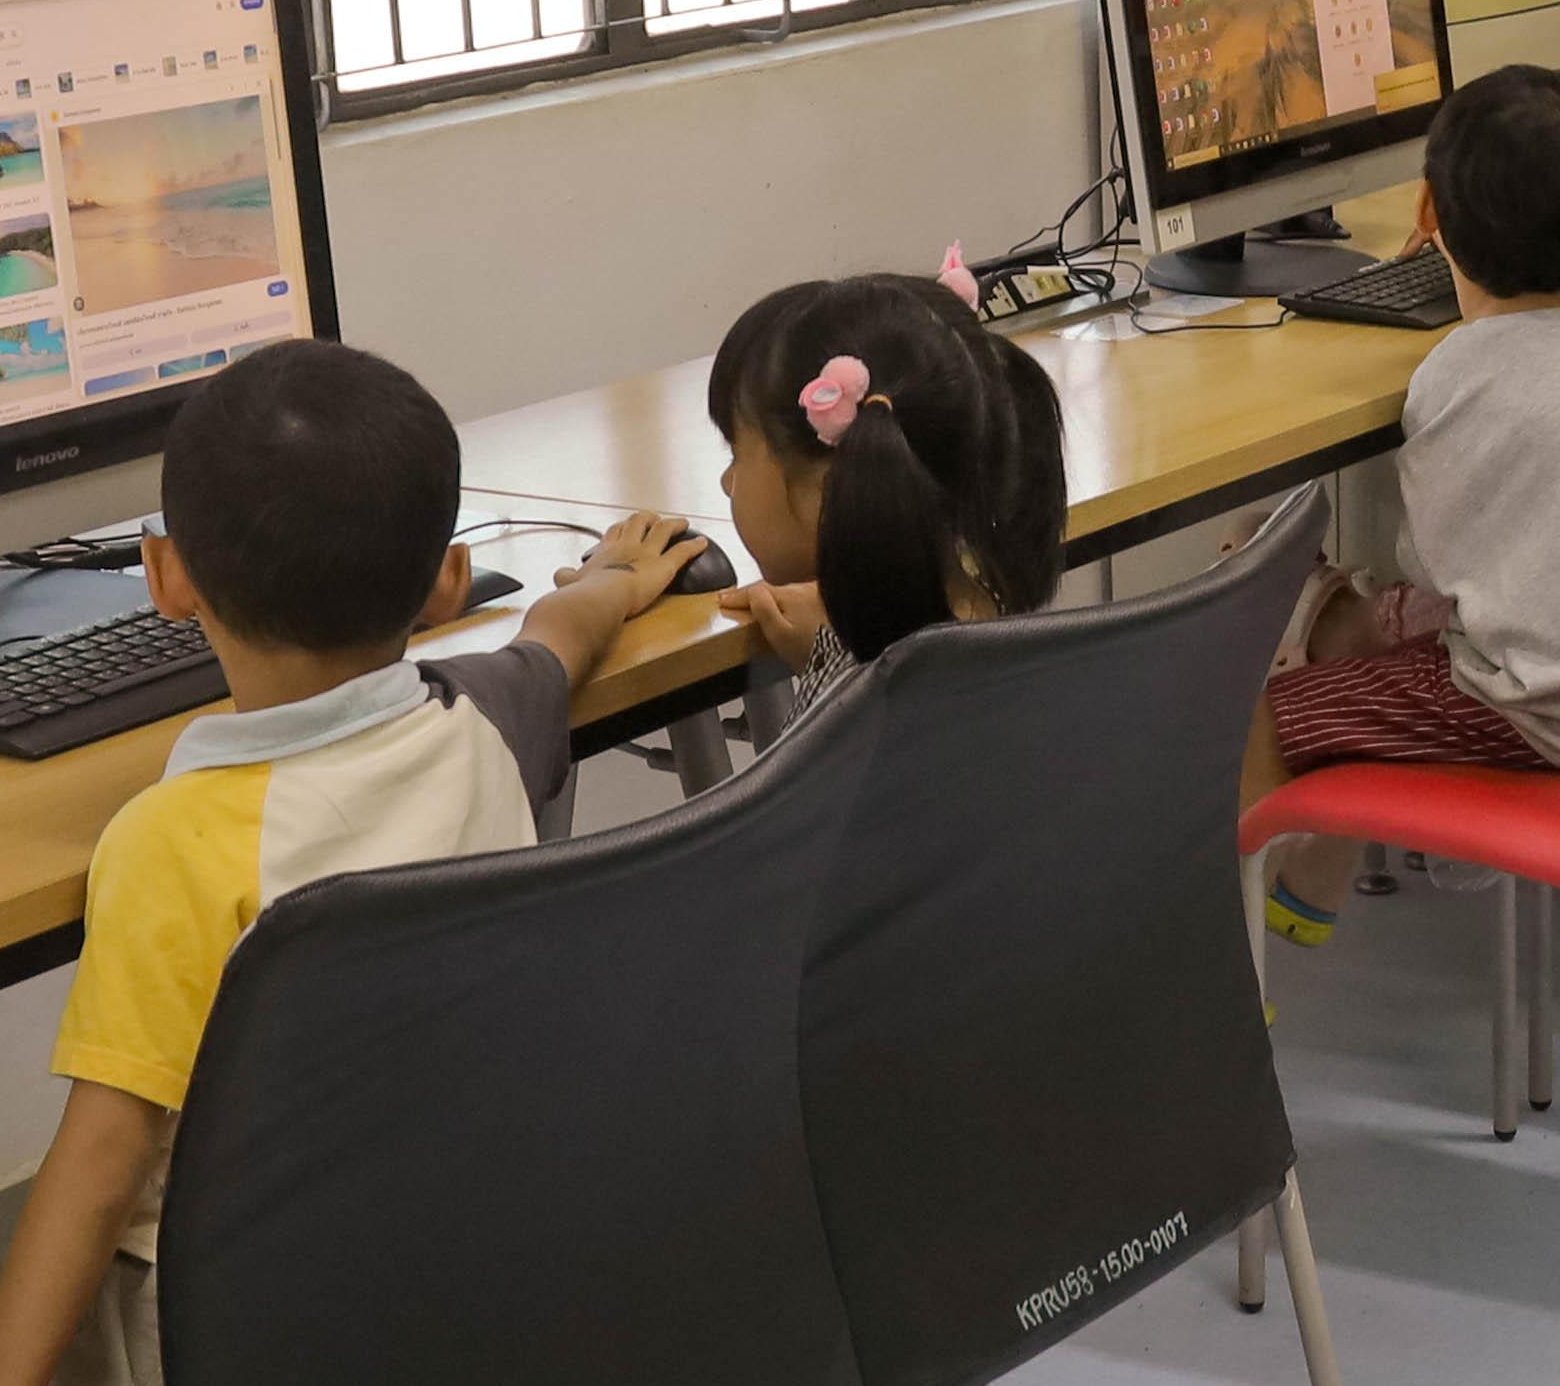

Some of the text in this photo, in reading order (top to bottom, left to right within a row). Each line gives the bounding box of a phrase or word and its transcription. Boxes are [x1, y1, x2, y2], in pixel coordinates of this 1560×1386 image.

[1166, 215, 1185, 235] 101
[15, 445, 81, 472] lenovo
[1015, 1210, 1190, 1331] KPRU58-15.00-0107
